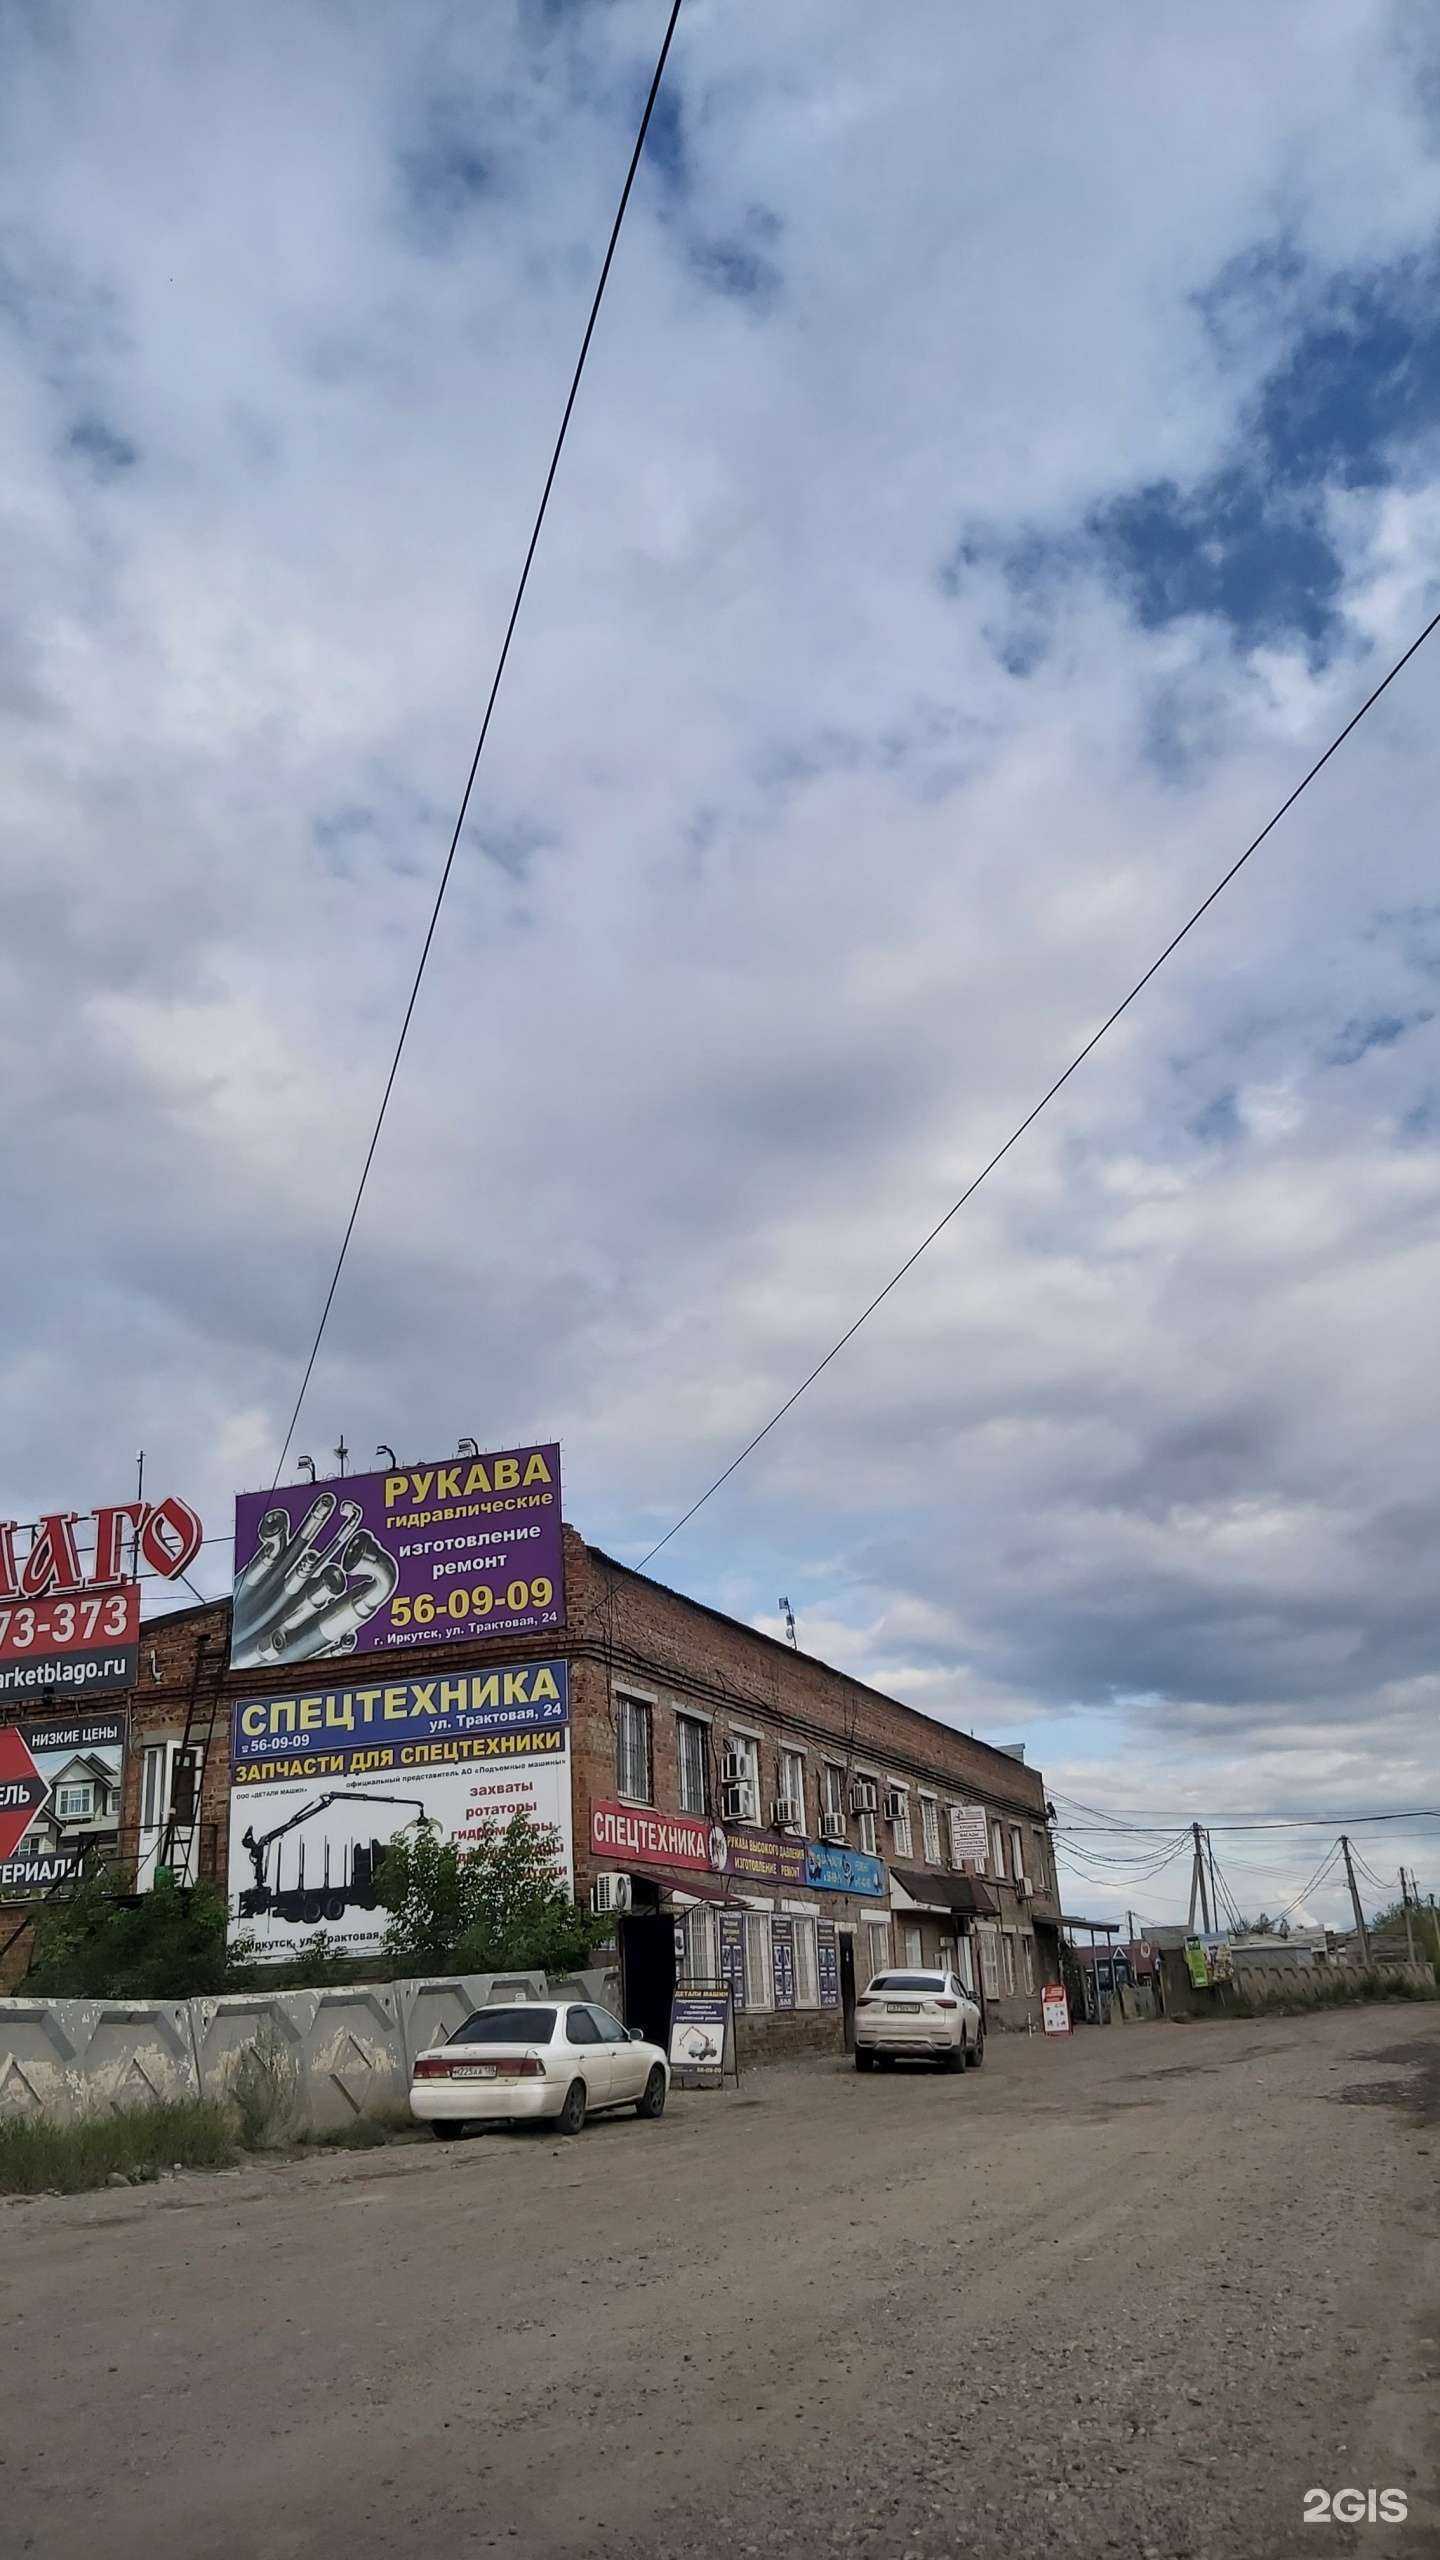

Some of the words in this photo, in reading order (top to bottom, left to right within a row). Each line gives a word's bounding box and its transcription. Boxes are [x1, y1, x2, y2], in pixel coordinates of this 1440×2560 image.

[385, 1454, 552, 1508] РУКАВА
[386, 1493, 553, 1529] гидравлические
[400, 1525, 541, 1557] изготовление
[432, 1555, 508, 1580] ремонт
[390, 1577, 553, 1627] 56-09-09
[374, 1636, 384, 1646] г.
[388, 1629, 442, 1645] Иркутск,
[446, 1625, 464, 1639] ул.
[468, 1616, 538, 1635] Трактовая,
[542, 1611, 557, 1623] 24
[241, 1667, 561, 1736] СПЕЦТЕХНИКА
[429, 1719, 451, 1733] ул.
[456, 1707, 539, 1728] Трактовая,
[543, 1702, 562, 1717] 24
[32, 1730, 80, 1747] НИЗКИЕ
[83, 1725, 118, 1744] ЦЕНЫ
[251, 1734, 310, 1752] 56-09-09
[236, 1754, 345, 1782] ЗАПЧАСТИ
[350, 1749, 394, 1772] ДЛЯ
[400, 1731, 561, 1764] СПЕЦТЕХНИКИ
[402, 1770, 460, 1783] представитель
[469, 1781, 534, 1797] захваты
[466, 1801, 537, 1820] ротаторы
[593, 1811, 706, 1858] СПЕЦТЕХНИКА
[0, 1858, 84, 1884] ЕРИАЛЫ
